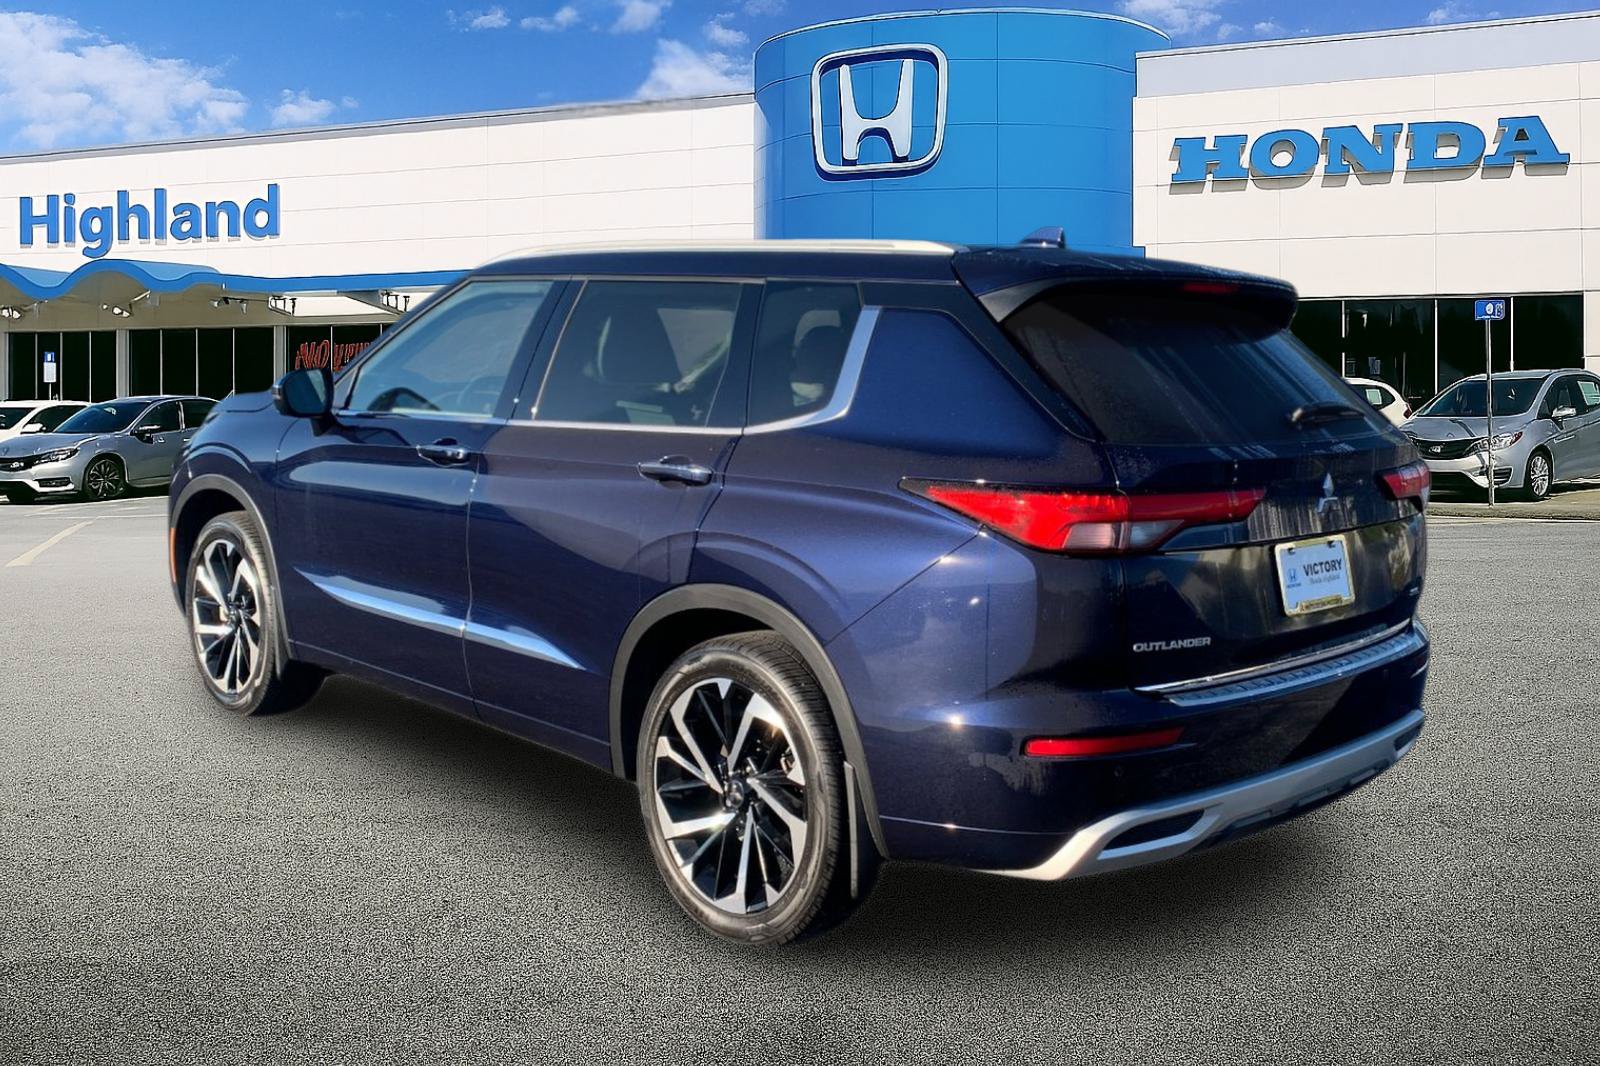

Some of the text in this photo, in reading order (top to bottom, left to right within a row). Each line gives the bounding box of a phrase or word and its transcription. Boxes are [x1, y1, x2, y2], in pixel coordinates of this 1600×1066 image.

[1171, 115, 1570, 186] HONDA
[19, 183, 280, 258] Highland
[1303, 558, 1342, 576] VICTORY
[1132, 636, 1212, 653] OUTLANDER
